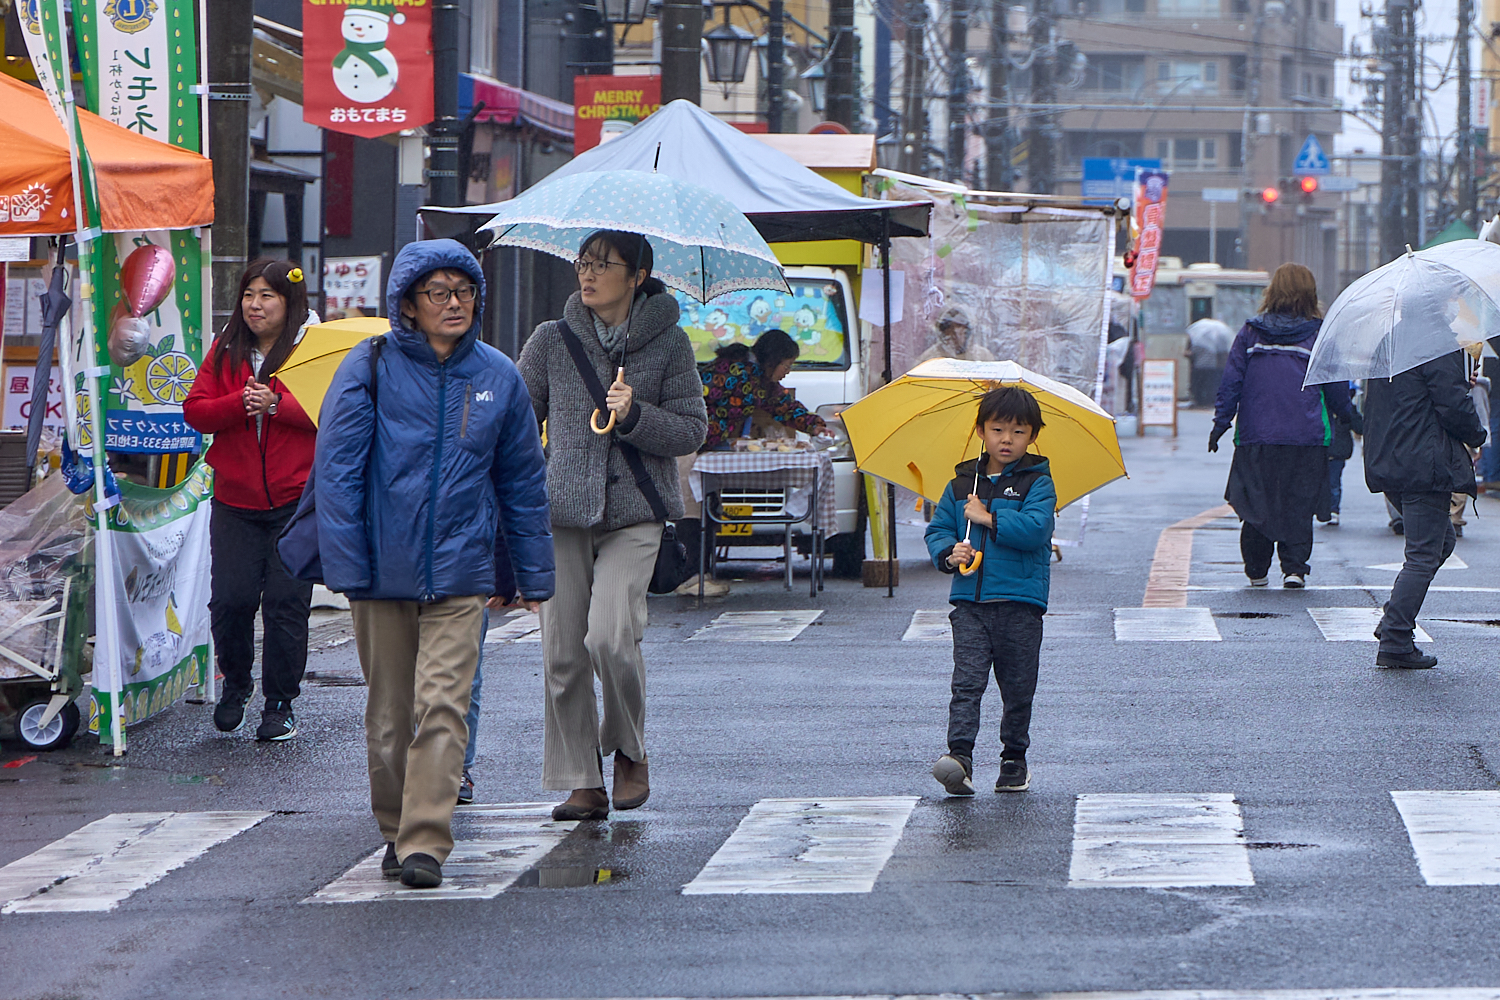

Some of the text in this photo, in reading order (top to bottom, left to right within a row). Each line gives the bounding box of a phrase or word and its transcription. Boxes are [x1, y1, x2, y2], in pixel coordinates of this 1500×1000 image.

[594, 90, 643, 104] MERRY
[330, 107, 407, 123] おもてまち
[13, 207, 31, 217] UV
